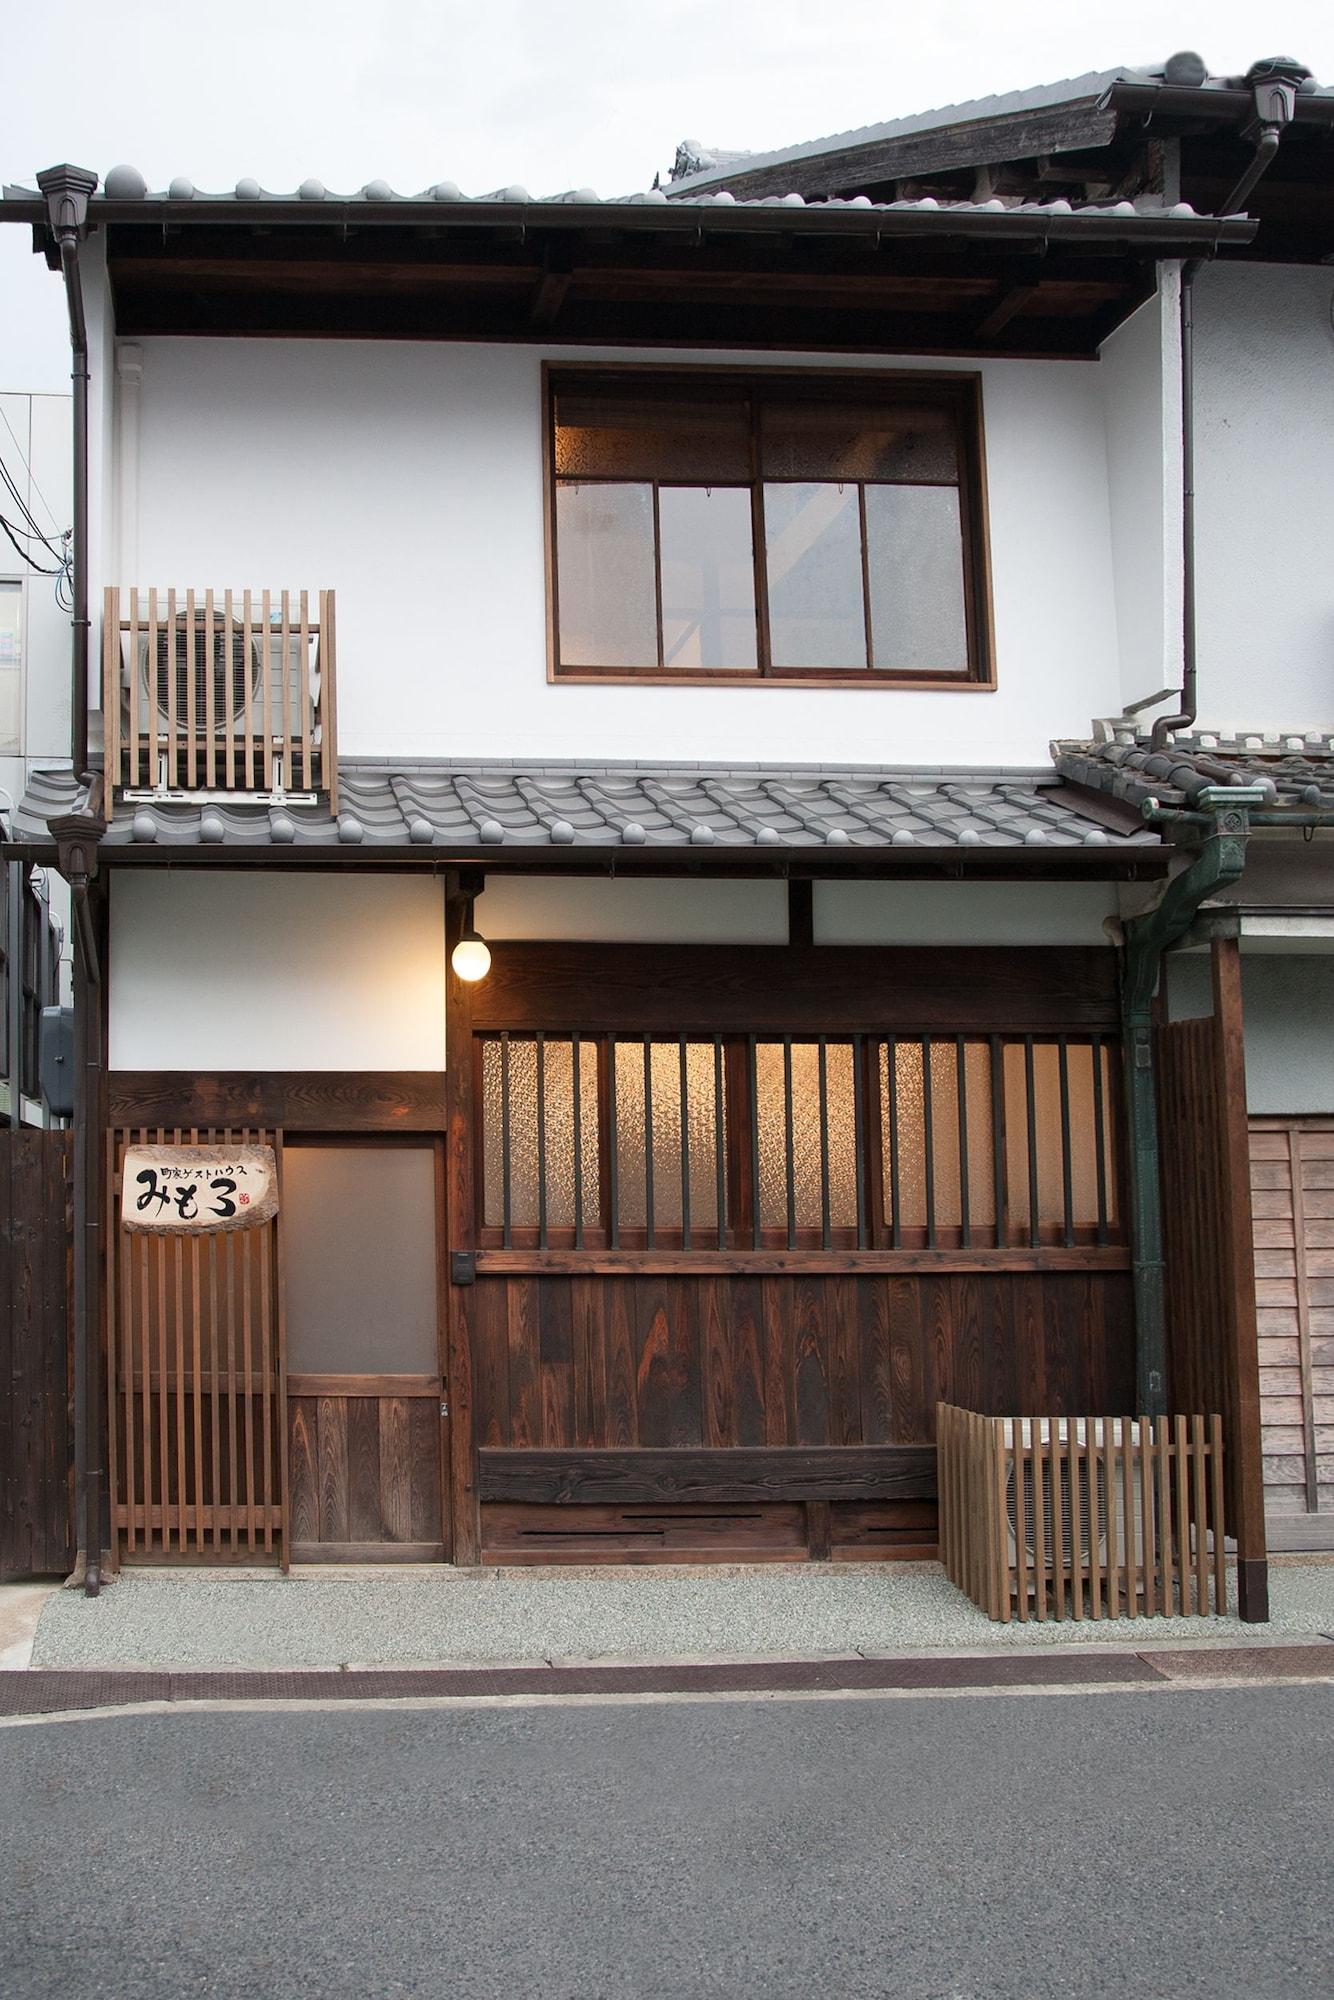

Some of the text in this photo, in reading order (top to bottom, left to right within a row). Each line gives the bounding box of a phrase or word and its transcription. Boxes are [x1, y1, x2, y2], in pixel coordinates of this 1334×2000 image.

[160, 1165, 248, 1180] 町家ゲストハウス
[136, 1169, 237, 1220] みもろ
